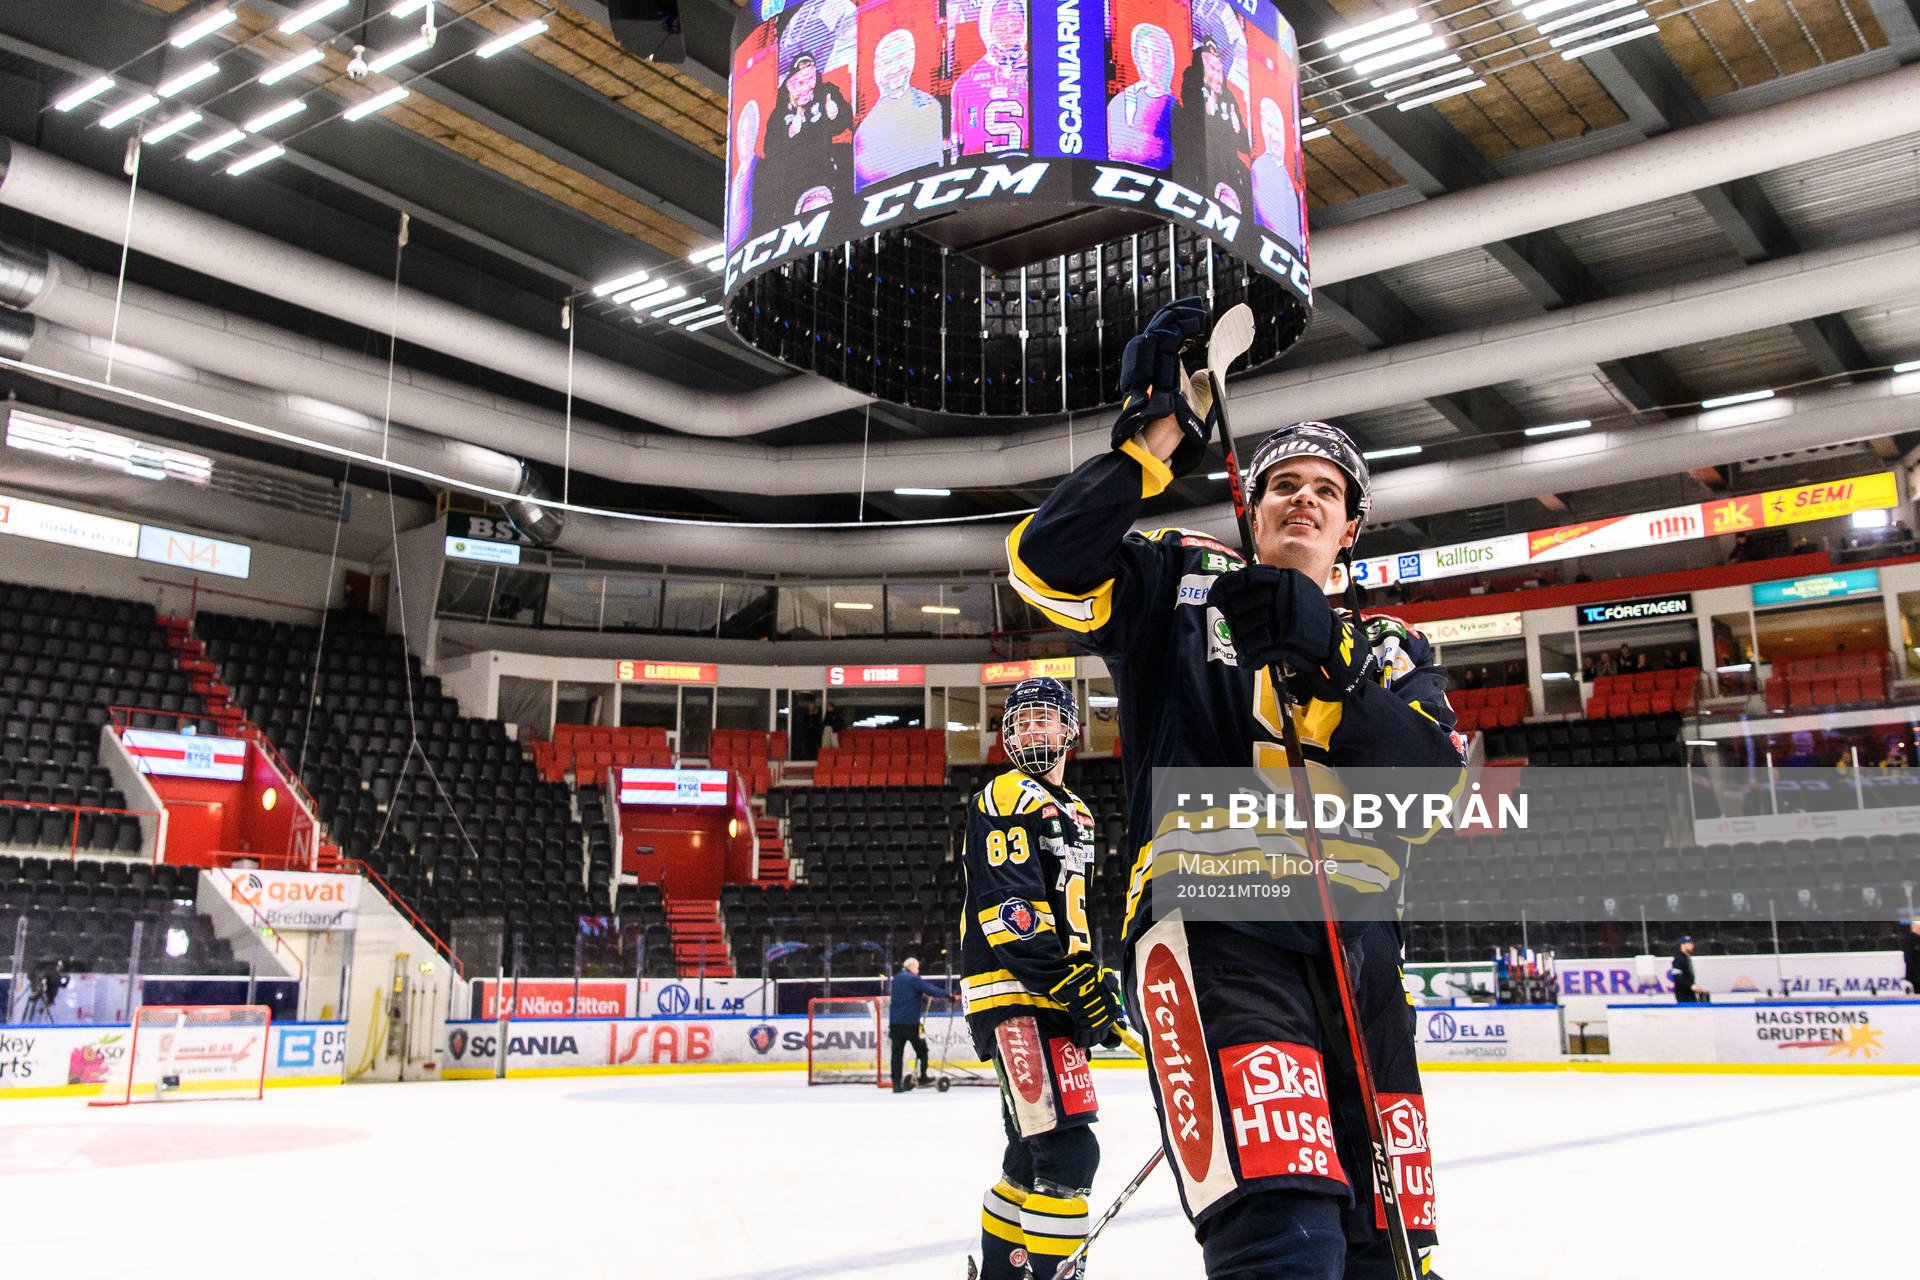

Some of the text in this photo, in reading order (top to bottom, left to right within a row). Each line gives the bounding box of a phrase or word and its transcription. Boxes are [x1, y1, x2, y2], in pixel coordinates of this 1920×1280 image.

[860, 163, 1049, 227] CCM
[1092, 166, 1240, 242] CCM
[725, 211, 830, 296] CCM
[1259, 235, 1309, 296] CC
[1795, 484, 1853, 507] SEMI
[469, 516, 517, 540] BS
[167, 535, 219, 568] N4
[1436, 546, 1494, 568] kallfors
[986, 826, 1030, 867] 83
[268, 881, 345, 903] qavat
[266, 910, 342, 926] Bredband
[521, 997, 561, 1015] Nära
[1756, 1007, 1869, 1024] HAGSTRÖMS
[609, 1022, 713, 1065] ISAB
[782, 1030, 877, 1051] SCANI
[1461, 1025, 1478, 1037] EL
[1484, 1025, 1505, 1037] AB
[1757, 1027, 1843, 1041] GRUPPEN
[470, 1035, 579, 1057] SCANIA
[1006, 1024, 1034, 1085] ritex
[1148, 977, 1200, 1142] Feritex
[1060, 1073, 1092, 1092] Hus
[1232, 1104, 1336, 1153] Huse
[1392, 1107, 1430, 1150] Sk
[1288, 1148, 1328, 1174] .se
[1372, 1141, 1394, 1204] CCM
